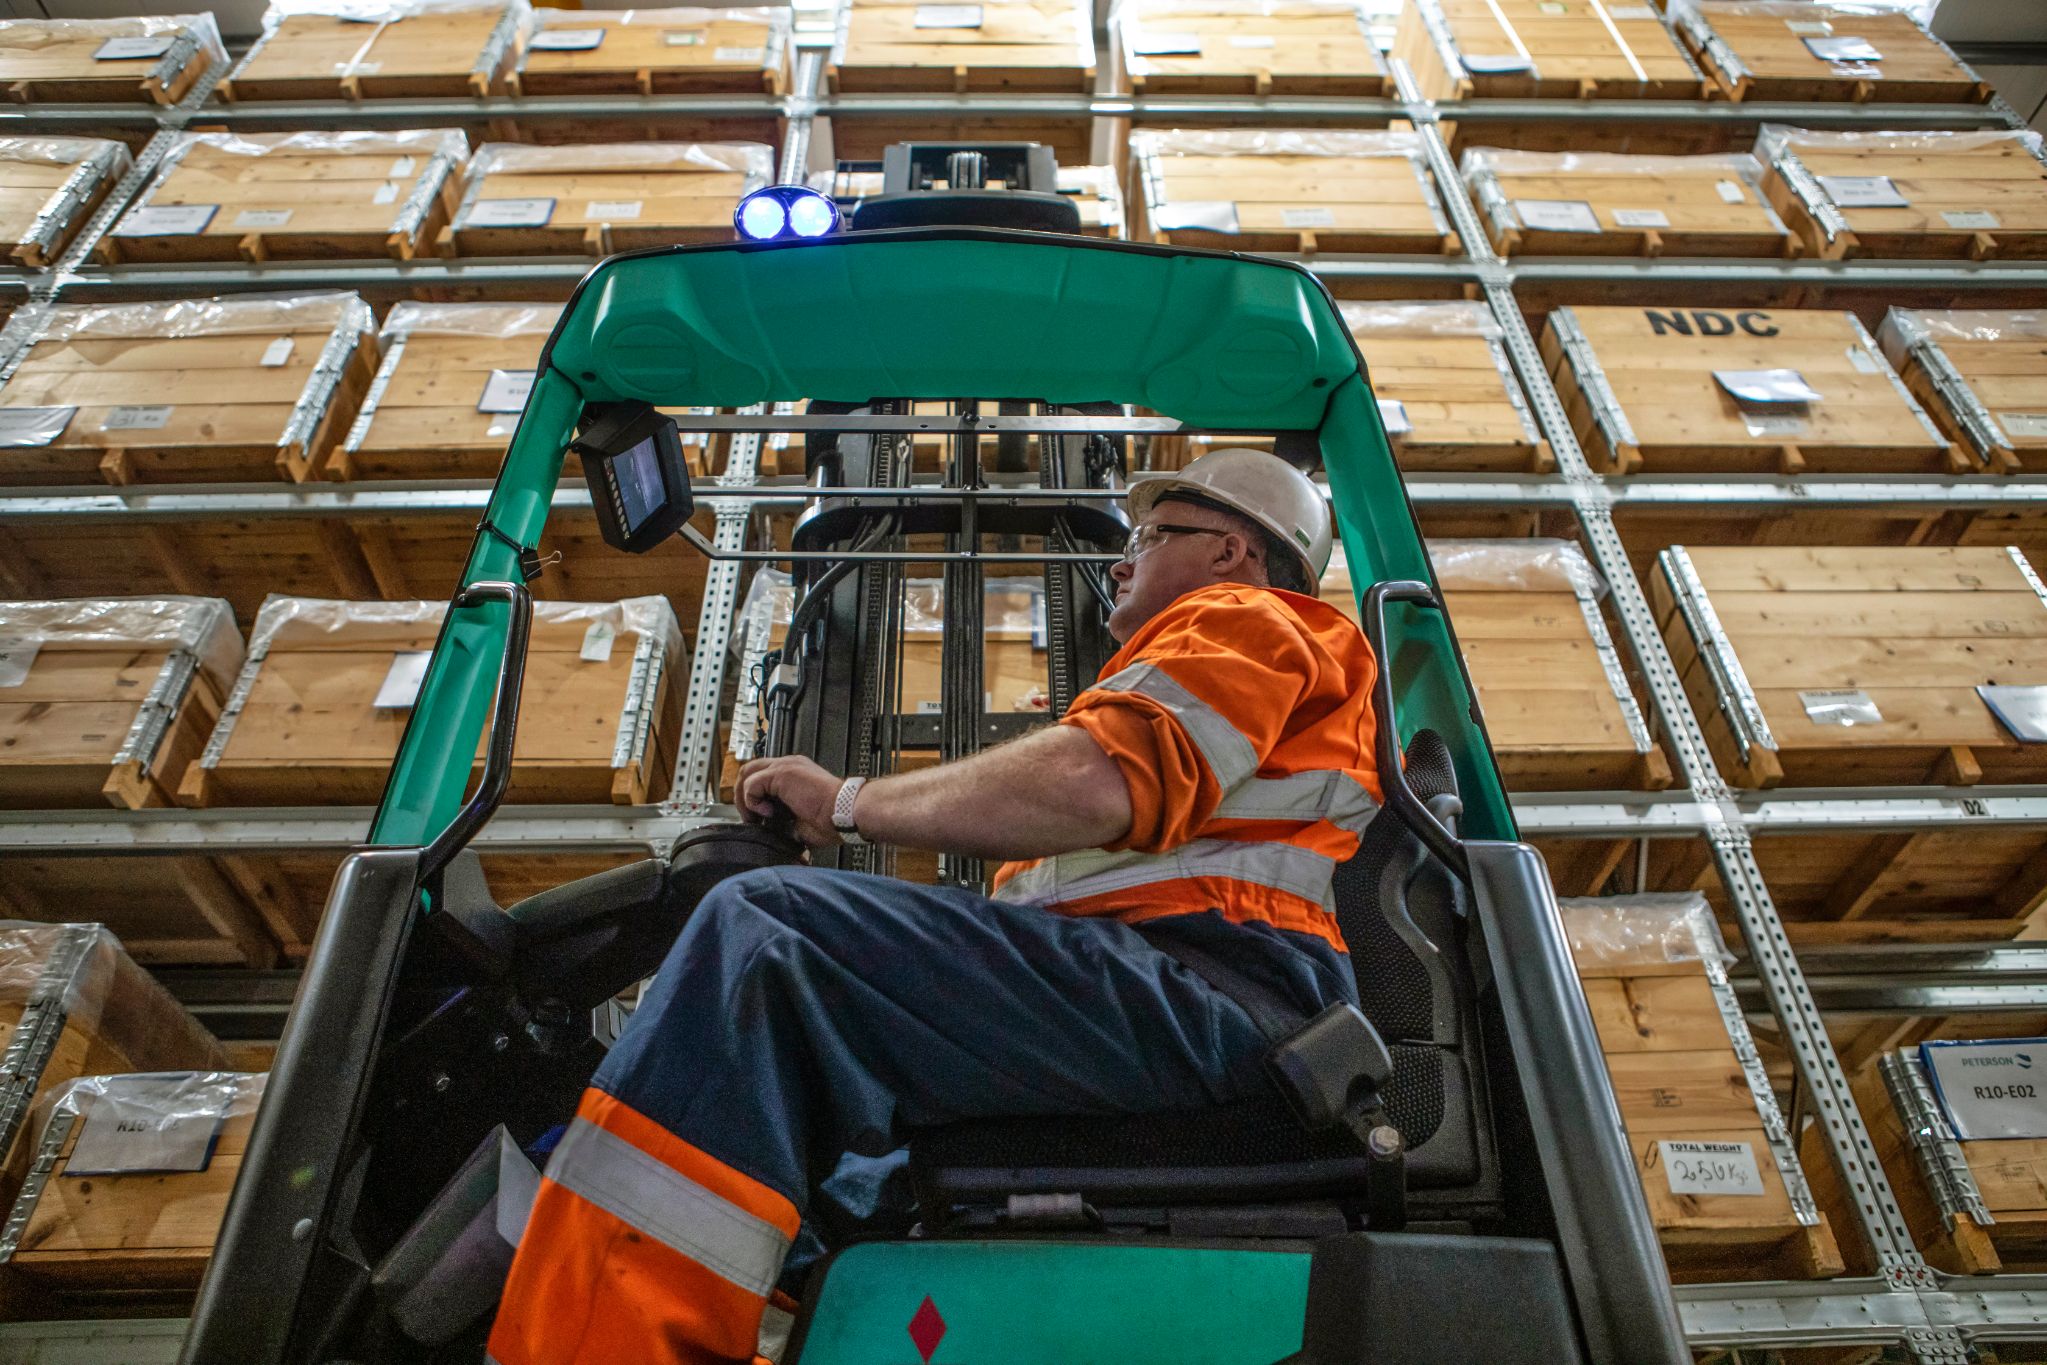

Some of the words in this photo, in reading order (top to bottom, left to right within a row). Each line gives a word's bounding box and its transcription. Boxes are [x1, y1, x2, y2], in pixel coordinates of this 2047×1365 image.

[1643, 309, 1780, 337] NDC
[1963, 800, 1986, 815] D2
[1961, 1057, 2014, 1067] PETERSON
[1974, 1085, 2038, 1099] R10-E02
[1669, 1143, 1700, 1152] TOTAL
[1703, 1144, 1743, 1152] WEIGHT
